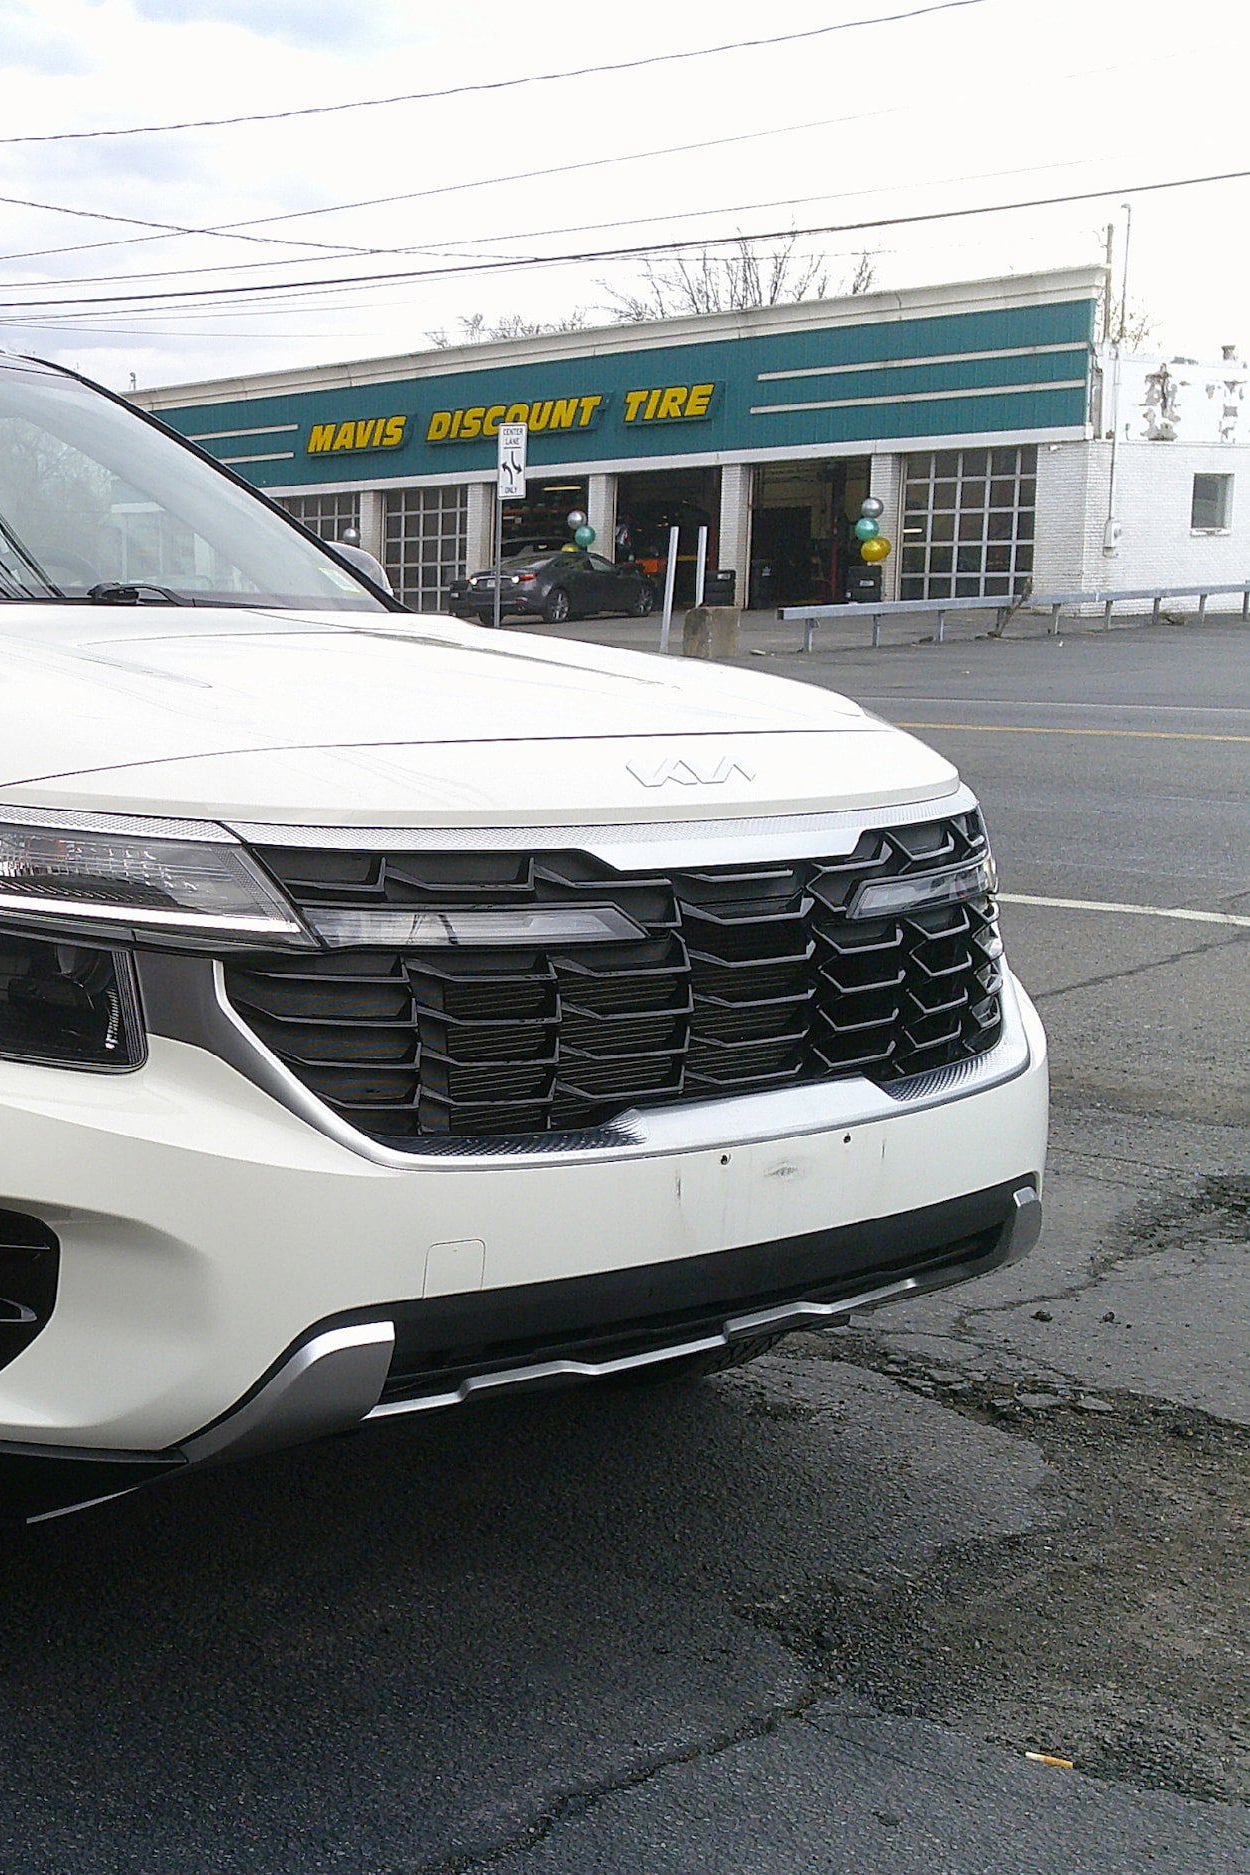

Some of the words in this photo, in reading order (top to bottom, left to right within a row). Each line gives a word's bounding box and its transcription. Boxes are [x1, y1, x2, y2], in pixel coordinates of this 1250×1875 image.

[307, 415, 407, 454] MAVIS
[426, 394, 603, 442] DISCOUNT
[624, 383, 716, 422] TIRE
[503, 427, 523, 436] CENTER
